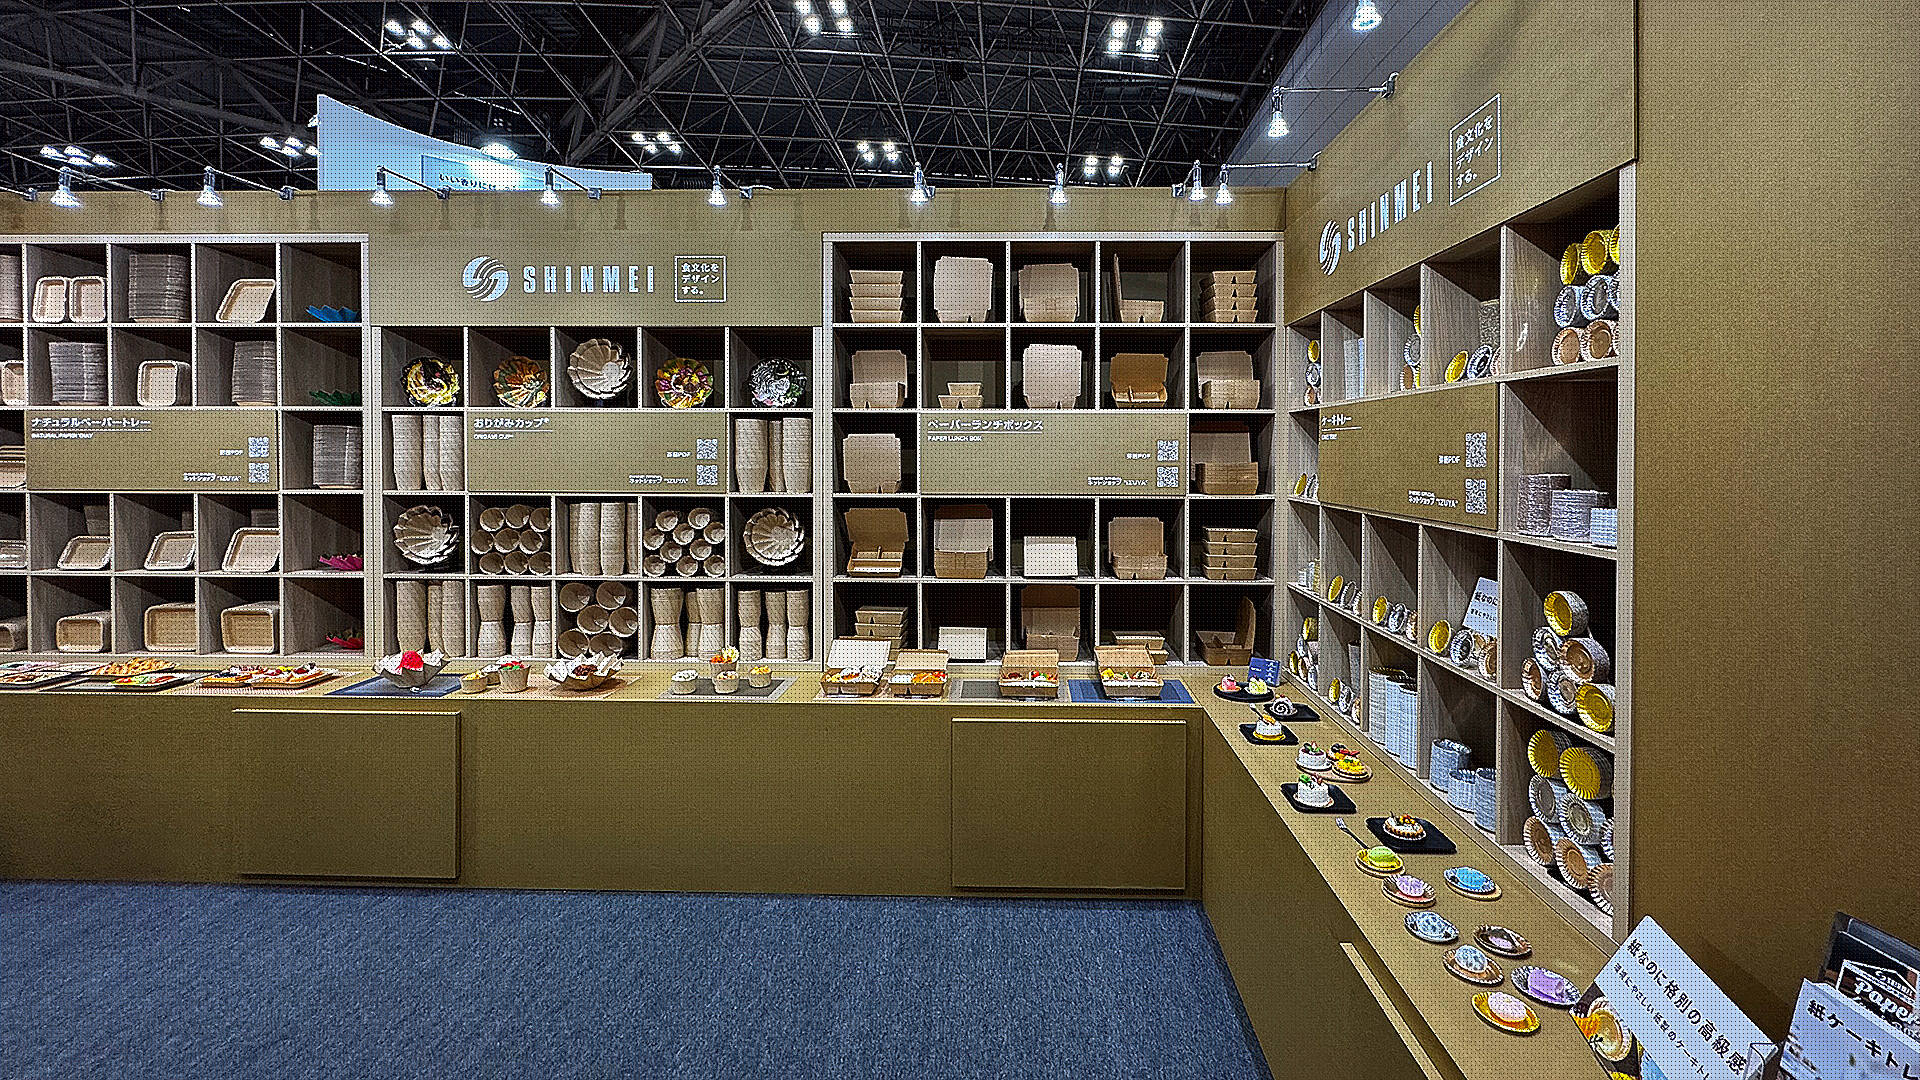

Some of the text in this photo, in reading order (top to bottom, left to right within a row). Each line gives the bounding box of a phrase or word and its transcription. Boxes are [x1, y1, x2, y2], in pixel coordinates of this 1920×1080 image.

[1456, 114, 1494, 151] 食文化を
[1456, 136, 1494, 170] デザイン
[1456, 168, 1478, 188] する。
[1347, 160, 1433, 252] SHINMEI
[681, 261, 720, 273] 食文化を
[522, 265, 655, 294] SHINMEI
[681, 273, 720, 284] デザイン
[681, 284, 705, 295] する。
[31, 417, 151, 428] ナチュラルペーパートレー
[927, 419, 1044, 431] ペーパーランチボックス
[1321, 413, 1352, 426] ケーキトレー
[1627, 938, 1748, 1076] 紙なのに格別の高級感
